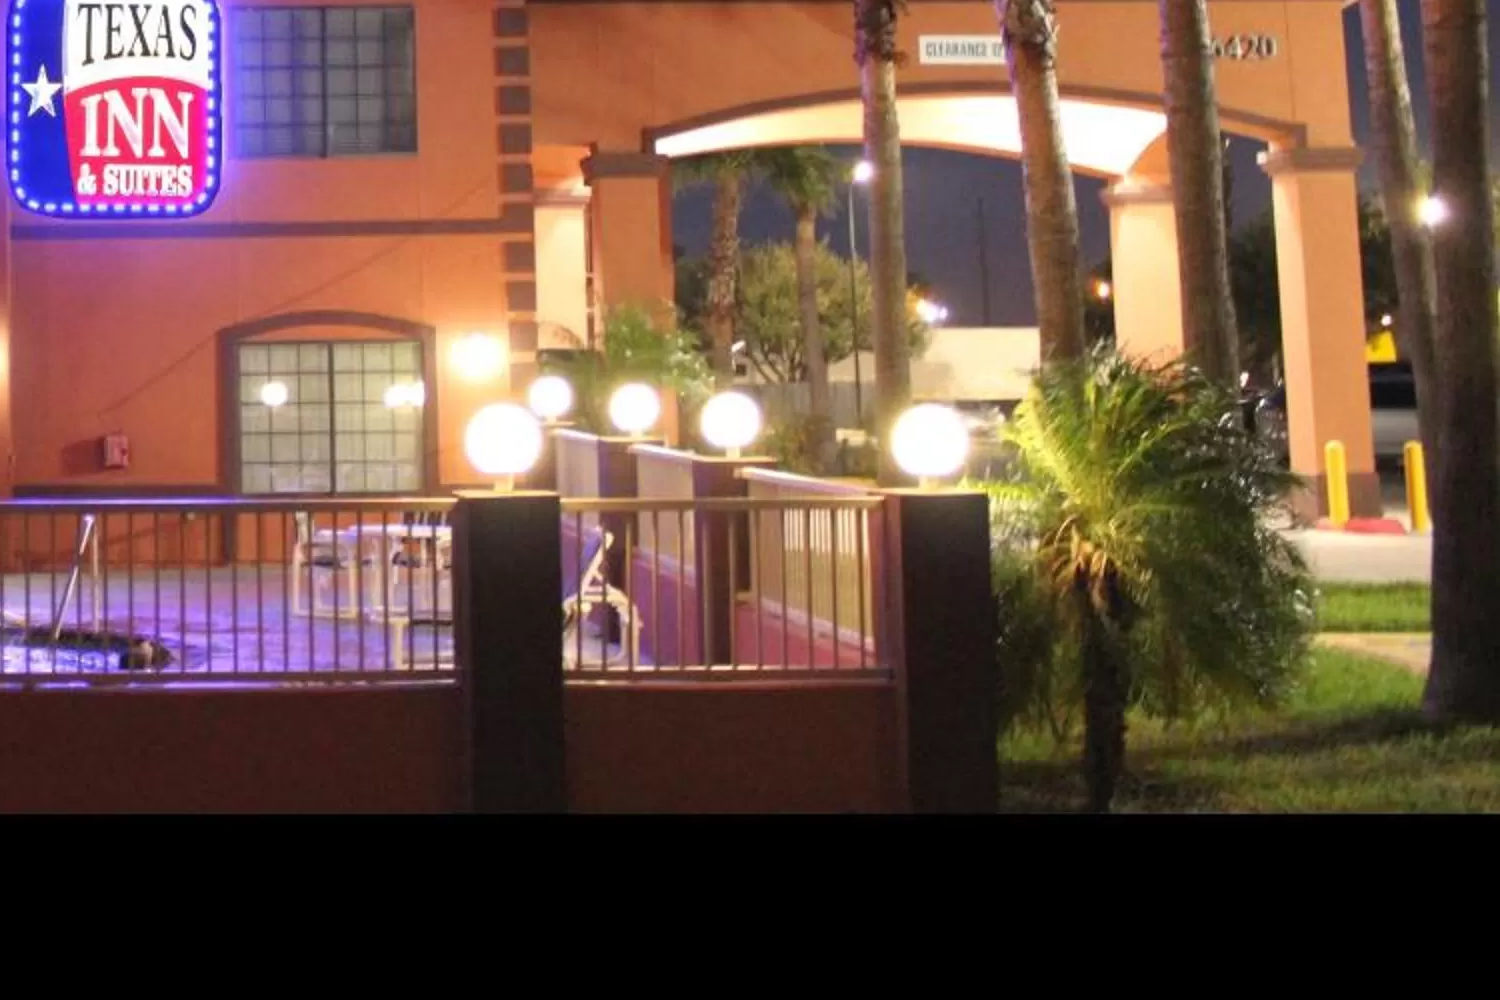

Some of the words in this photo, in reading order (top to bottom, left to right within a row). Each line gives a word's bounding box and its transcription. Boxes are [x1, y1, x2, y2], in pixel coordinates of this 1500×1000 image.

[76, 3, 197, 66] TEXAS
[79, 87, 194, 158] INN
[77, 163, 97, 196] &
[102, 164, 194, 196] SUITES
